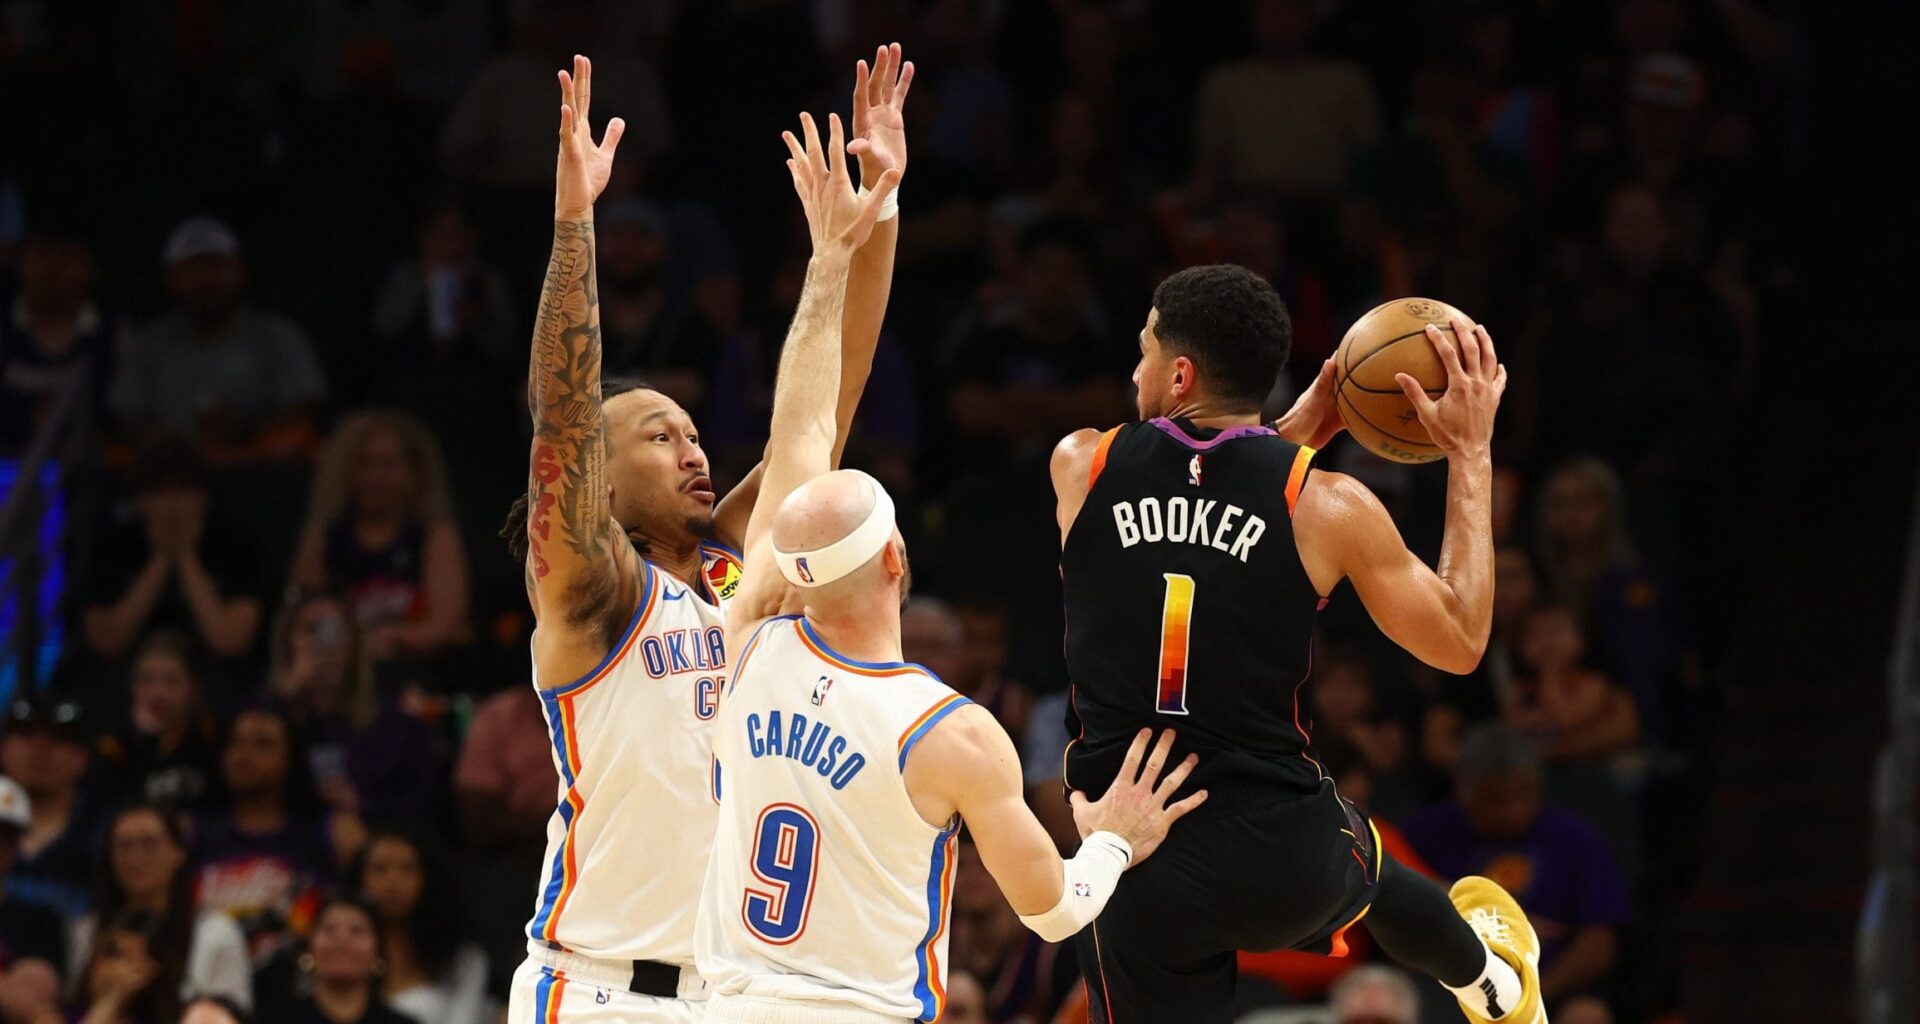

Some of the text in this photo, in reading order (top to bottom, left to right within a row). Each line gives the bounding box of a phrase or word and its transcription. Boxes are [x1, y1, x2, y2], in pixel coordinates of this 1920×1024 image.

[1112, 496, 1266, 563] BOOKER
[1155, 572, 1196, 715] 1
[747, 710, 866, 791] CARUSO
[741, 802, 821, 946] 9
